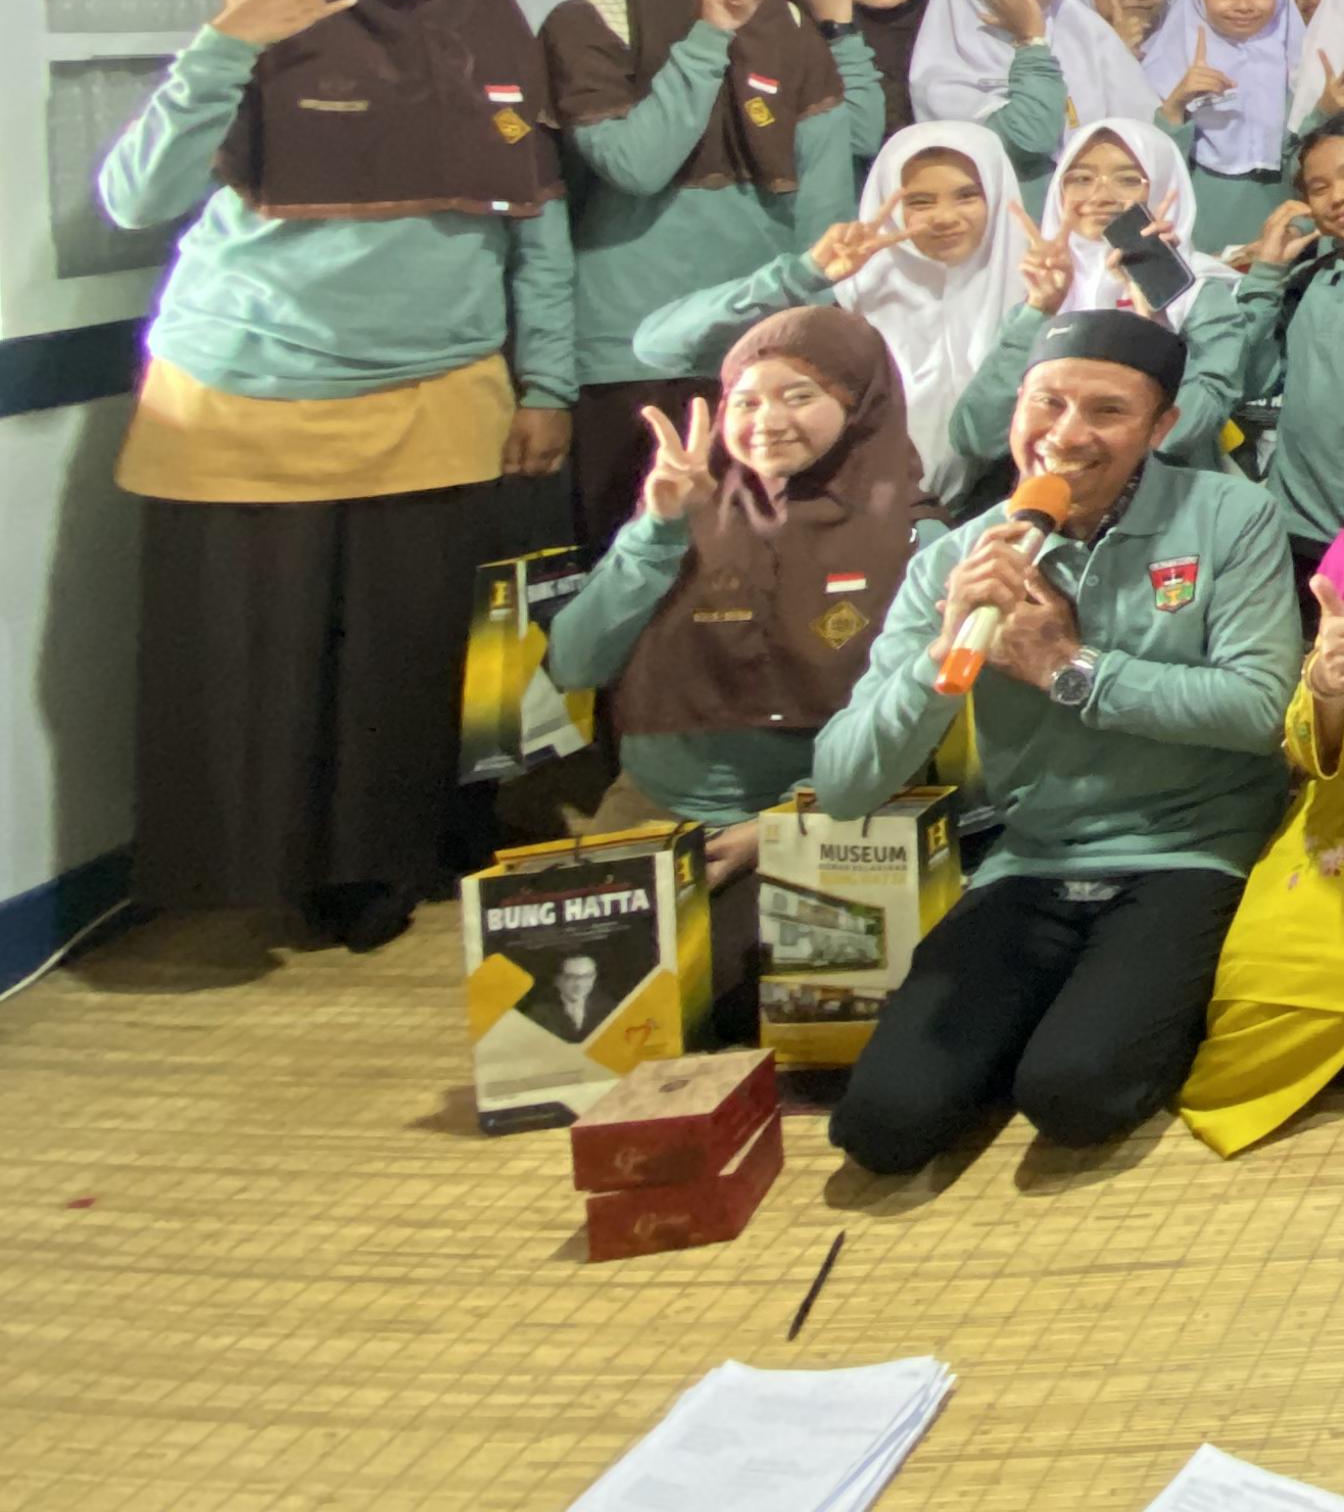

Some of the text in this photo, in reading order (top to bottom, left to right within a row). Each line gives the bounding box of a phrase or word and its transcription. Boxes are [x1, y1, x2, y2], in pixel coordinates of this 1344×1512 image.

[820, 843, 907, 863] MUSEUM
[487, 902, 556, 931] BUNG
[564, 888, 650, 922] HATTA
